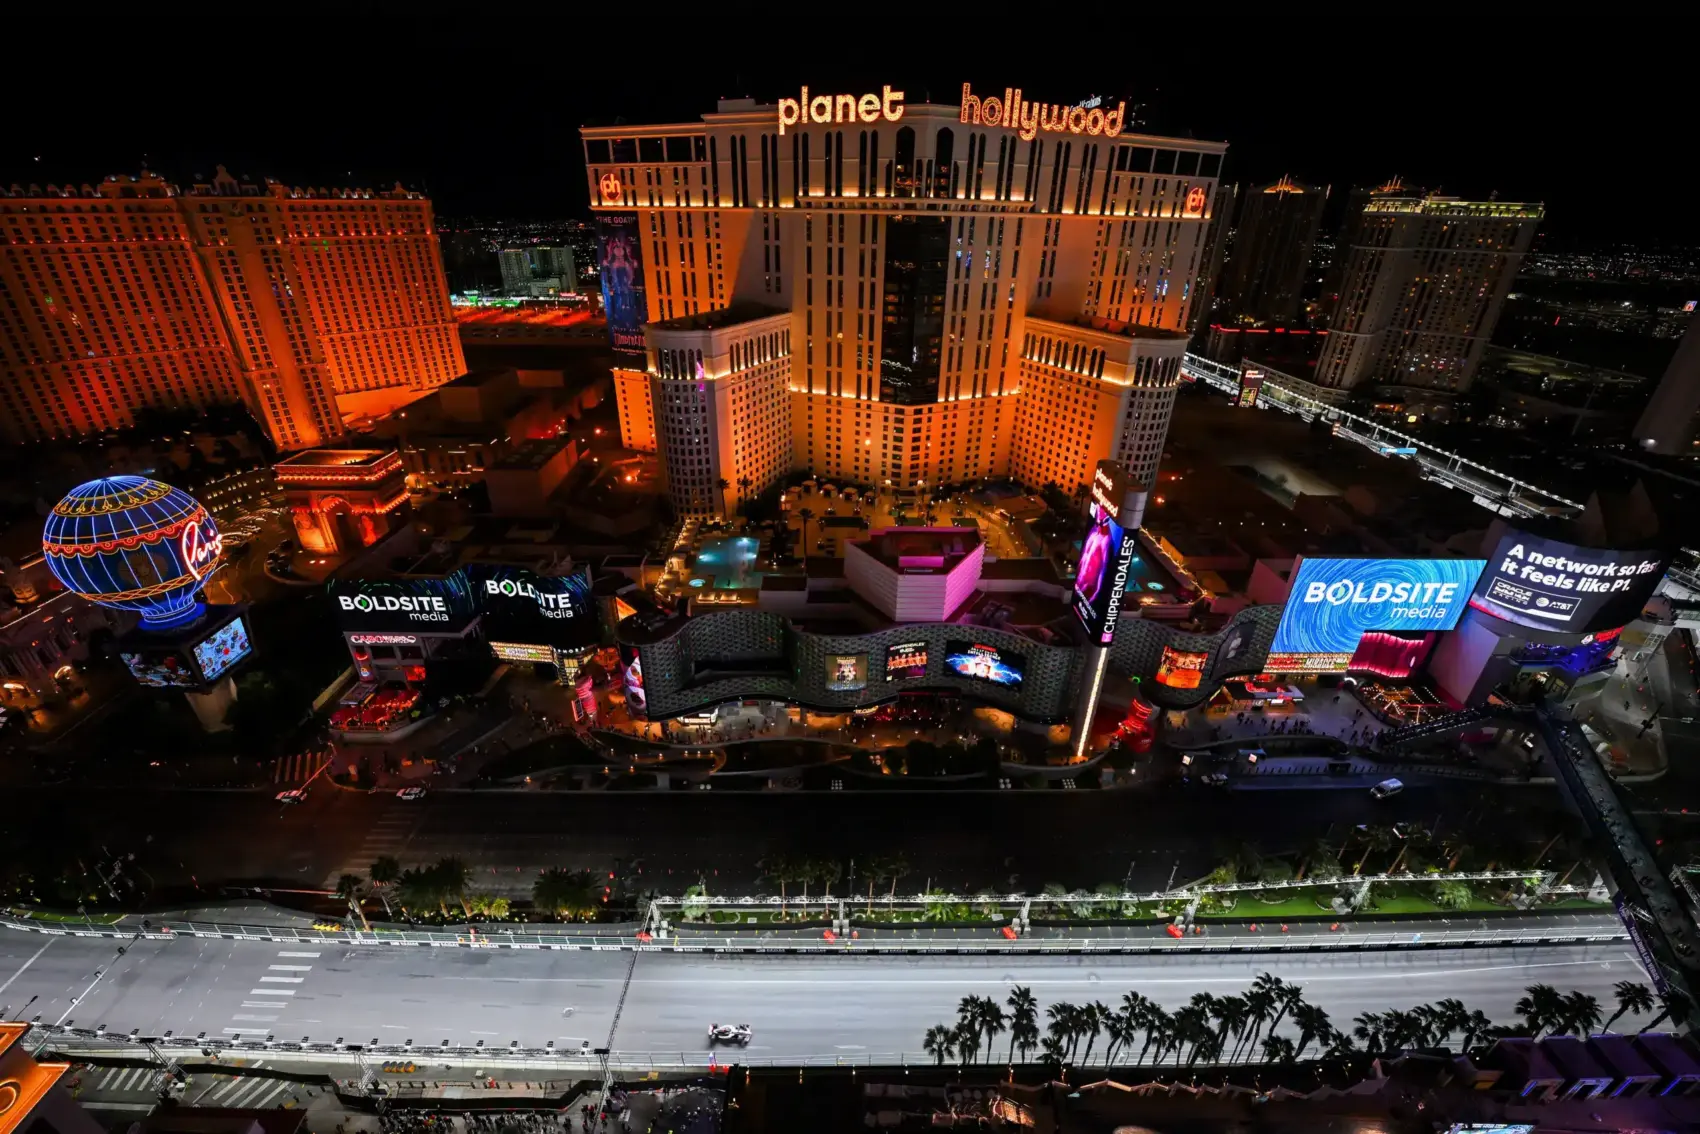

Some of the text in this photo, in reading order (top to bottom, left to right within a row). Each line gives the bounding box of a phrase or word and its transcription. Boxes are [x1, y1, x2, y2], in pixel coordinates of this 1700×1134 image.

[778, 85, 905, 135] planet
[959, 82, 1126, 141] hollywood
[182, 521, 223, 580] Paris
[1507, 543, 1524, 560] A
[1527, 551, 1619, 577] network
[1618, 565, 1636, 577] so
[1103, 537, 1134, 633] CHIPPENDALES
[1497, 581, 1533, 597] ORACLE
[1500, 558, 1631, 593] it feels like P1.
[338, 594, 447, 613] BOLDSITE
[485, 578, 571, 608] BOLDSITE
[1303, 579, 1460, 606] BOLDSITE
[1549, 601, 1574, 611] AT&T
[409, 611, 449, 622] media
[1390, 605, 1447, 619] media
